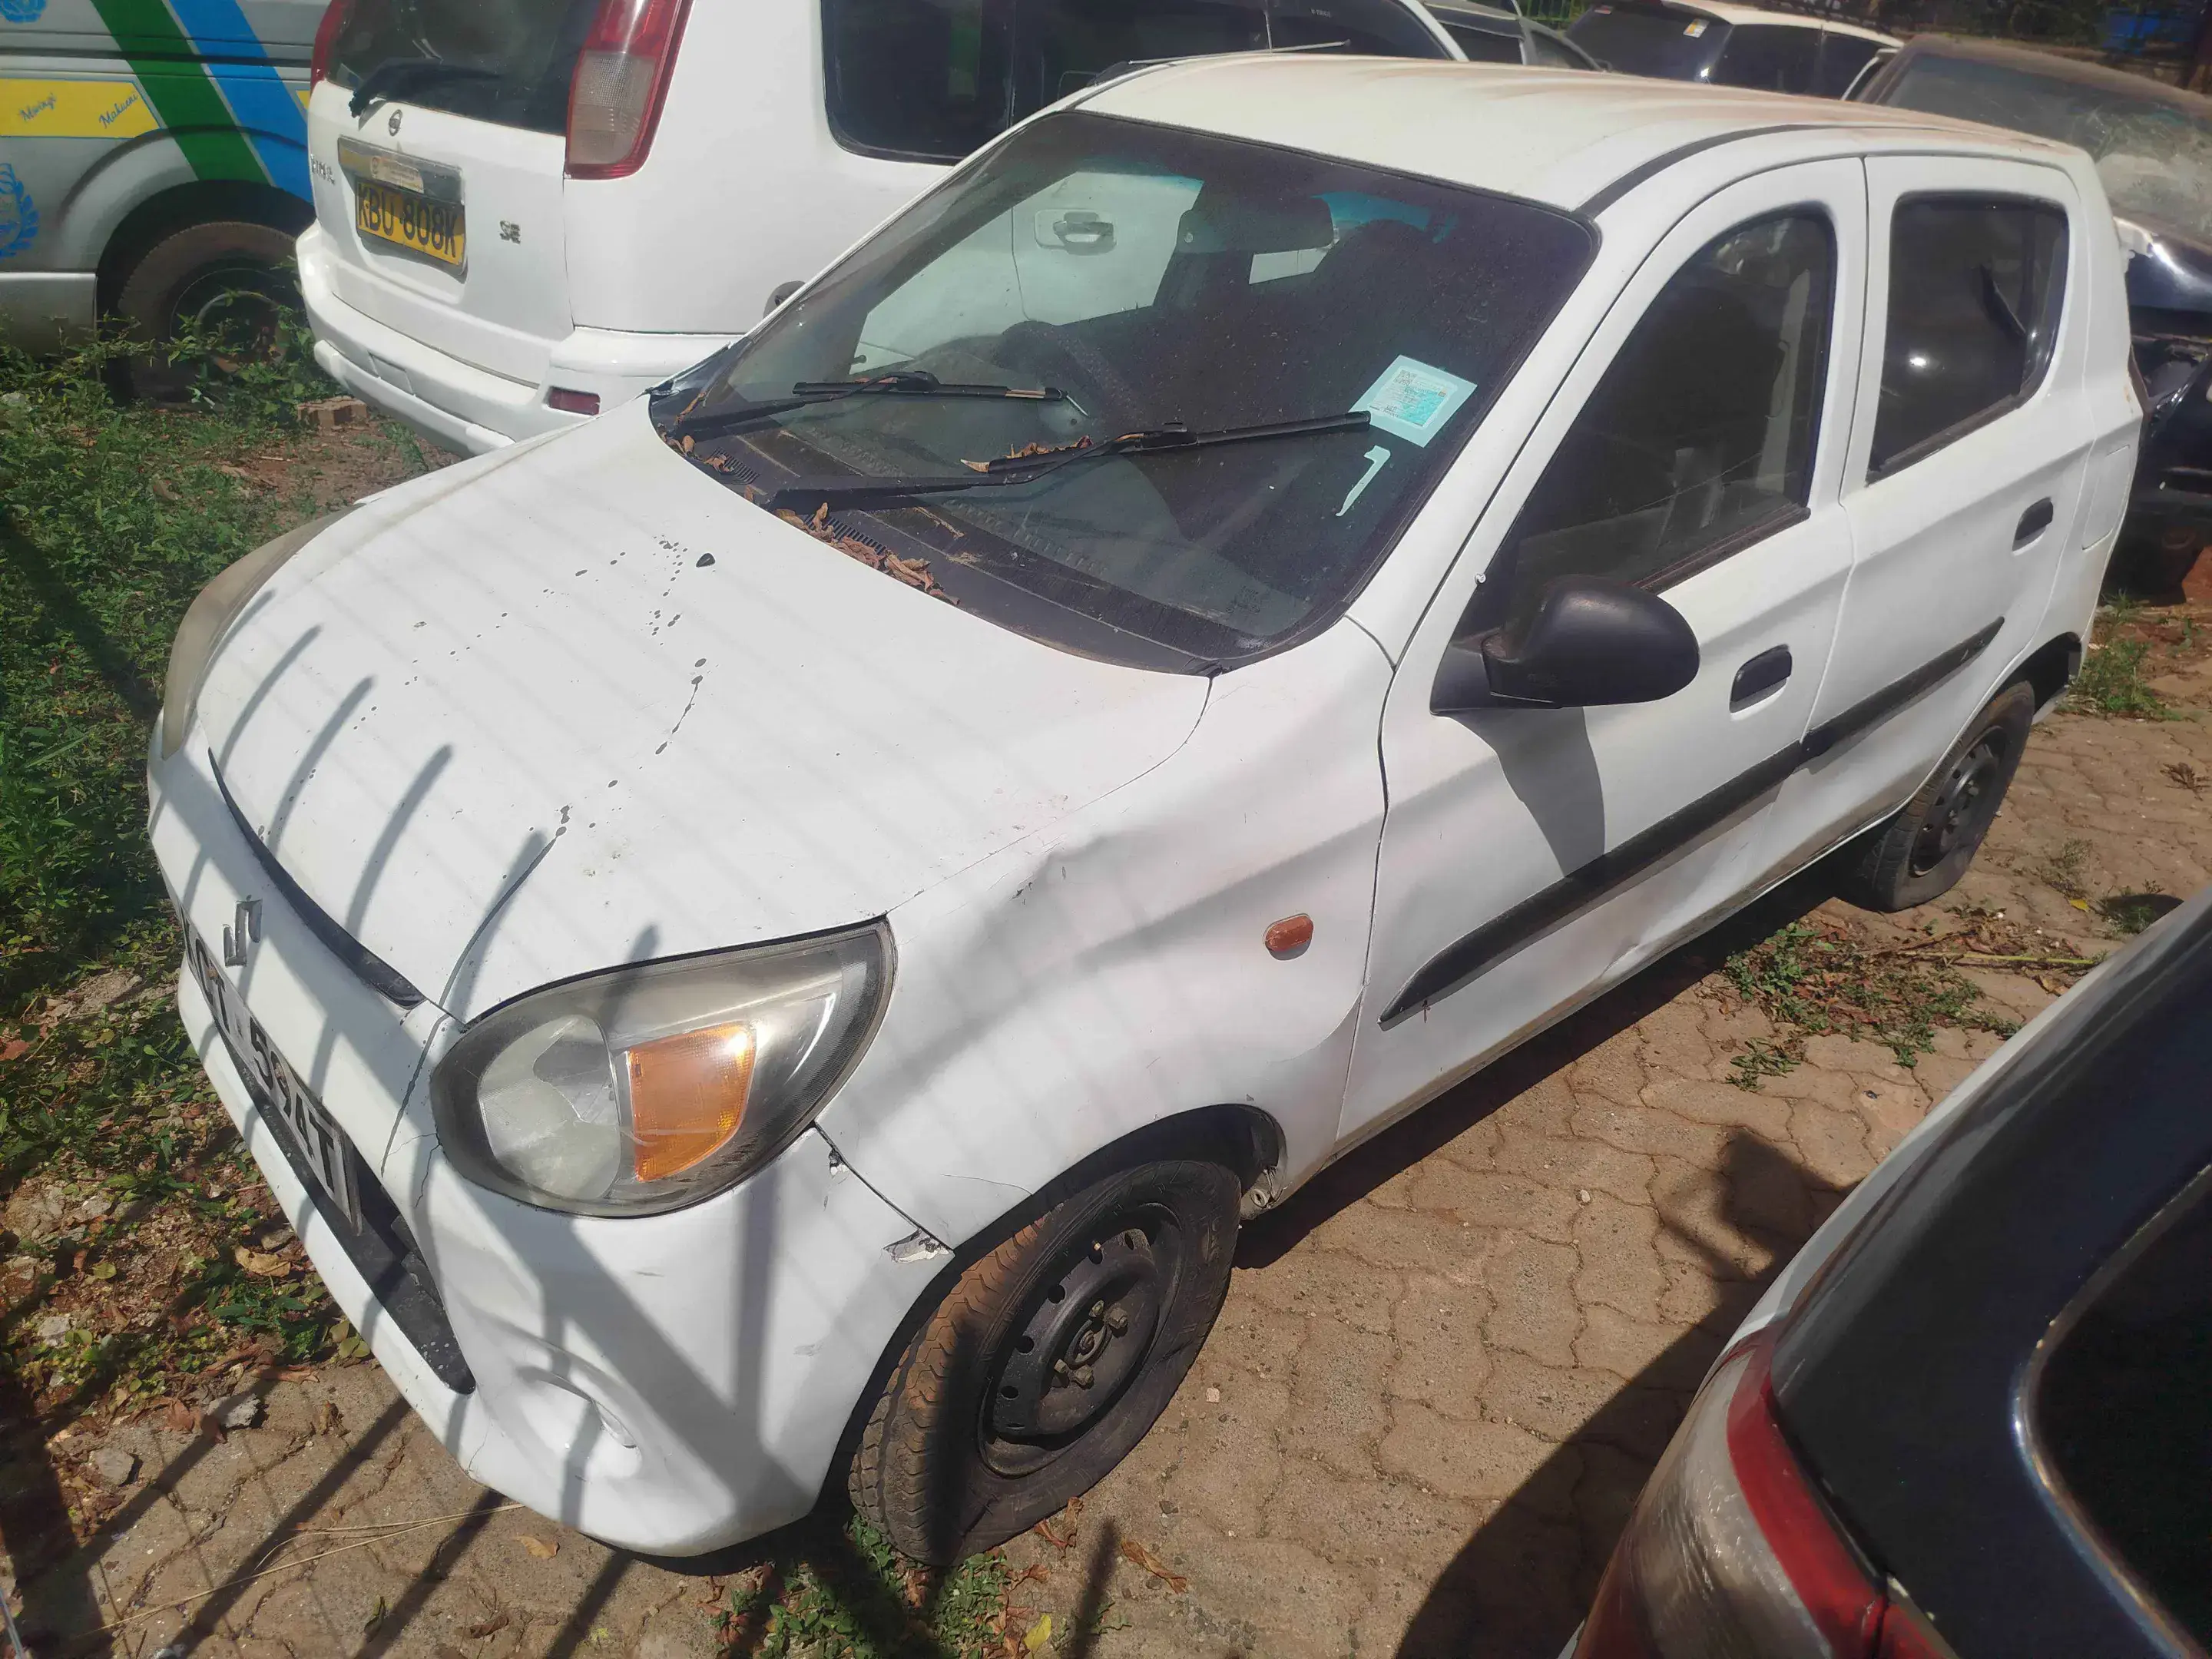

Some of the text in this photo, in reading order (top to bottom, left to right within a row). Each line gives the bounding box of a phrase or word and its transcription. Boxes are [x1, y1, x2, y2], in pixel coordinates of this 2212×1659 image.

[98, 93, 140, 129] Makueni
[358, 182, 459, 259] KBU 808K
[499, 220, 521, 244] SE
[250, 1016, 335, 1193] 594T
